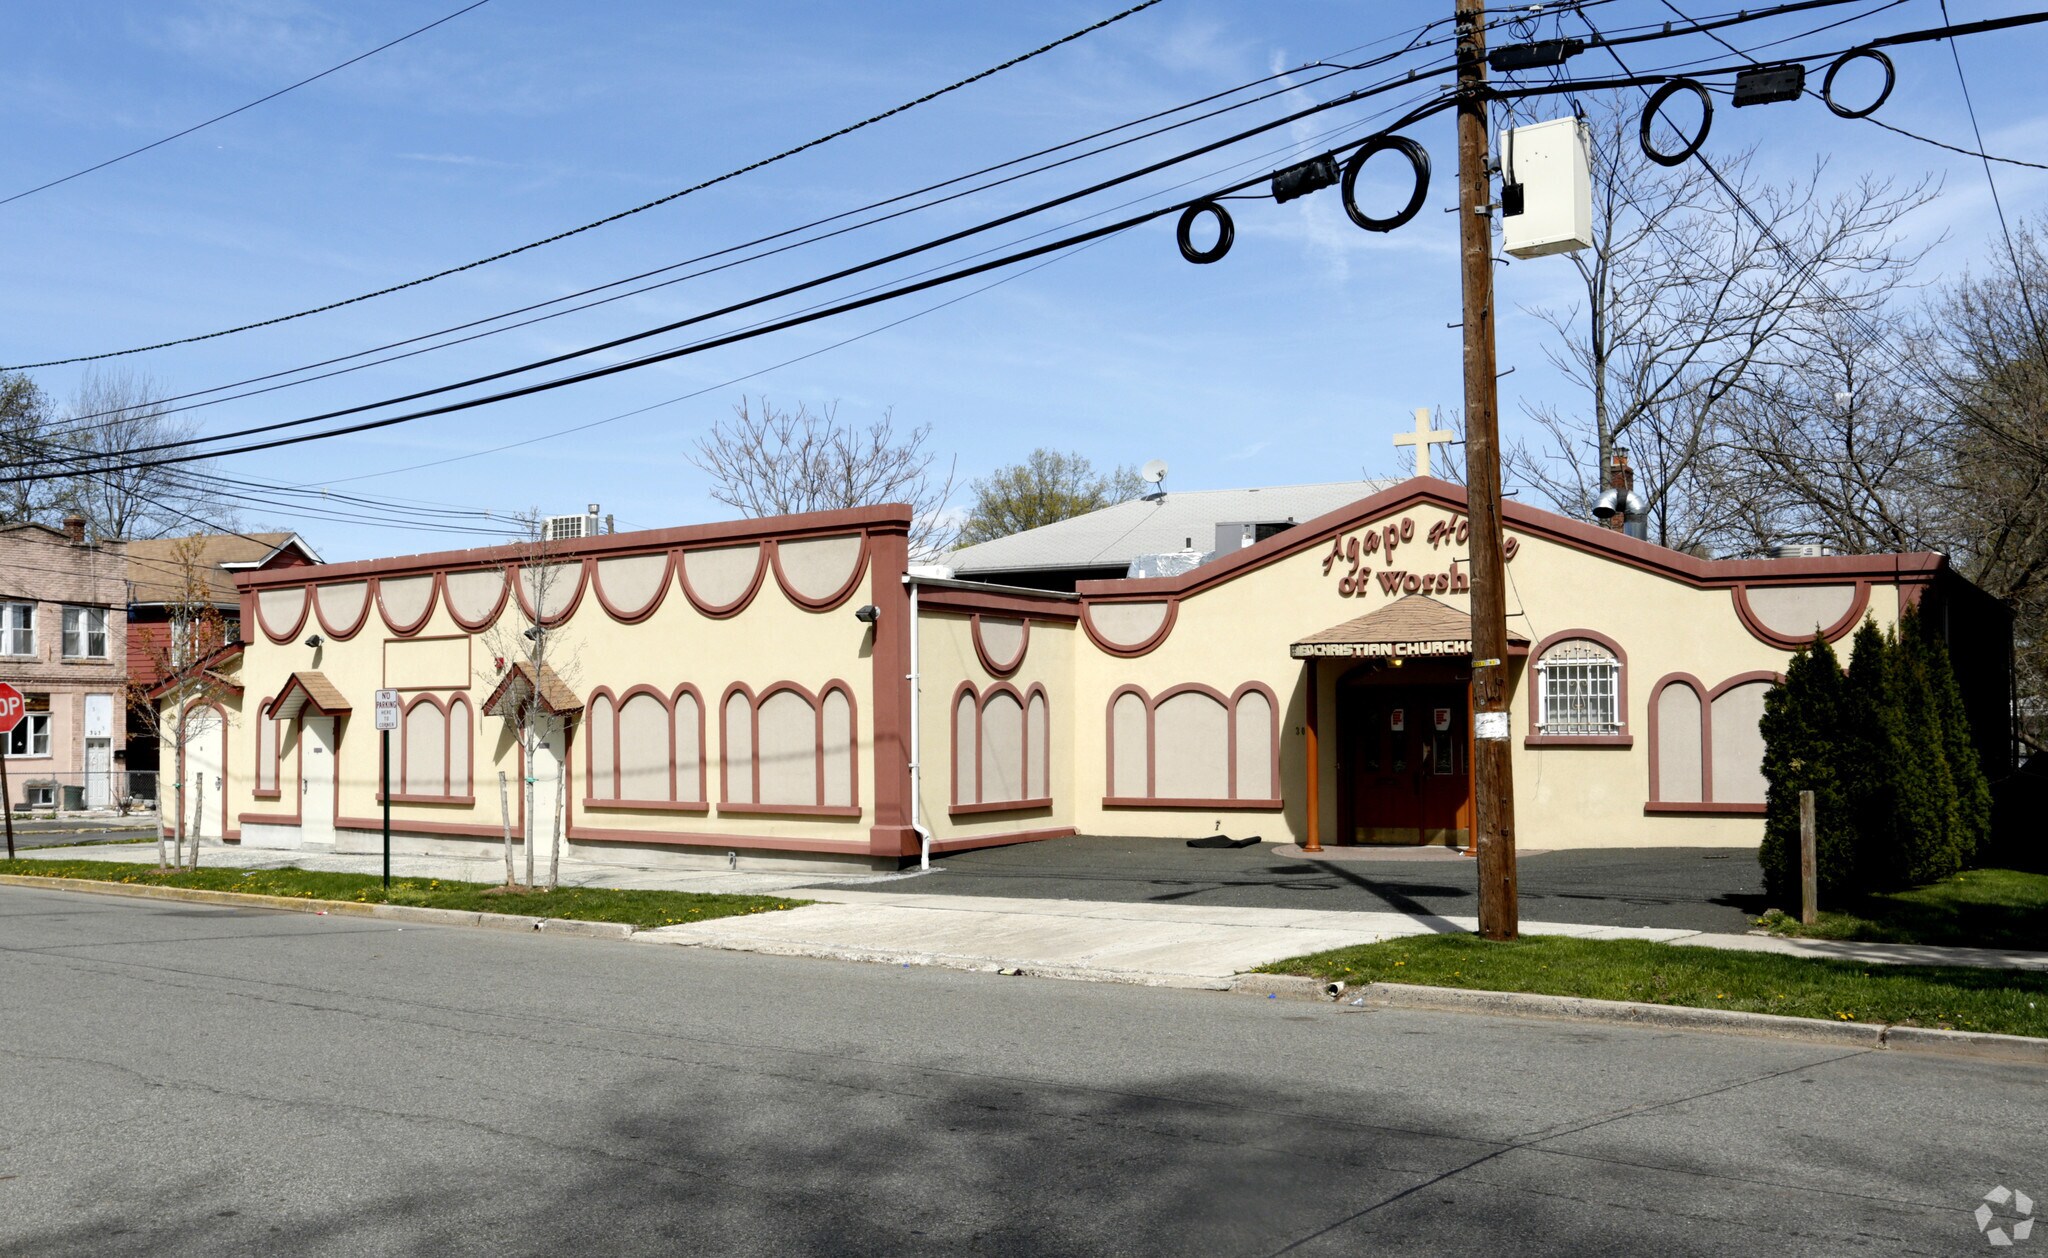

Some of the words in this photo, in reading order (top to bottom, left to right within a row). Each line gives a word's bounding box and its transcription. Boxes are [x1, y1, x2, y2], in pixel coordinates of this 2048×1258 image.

[1322, 517, 1415, 574] Agape
[1427, 514, 1520, 560] Hoe
[1339, 567, 1371, 593] of
[1377, 563, 1470, 593] Worsh
[1314, 643, 1392, 656] CHRISTIAN
[1395, 641, 1465, 655] CHURCH
